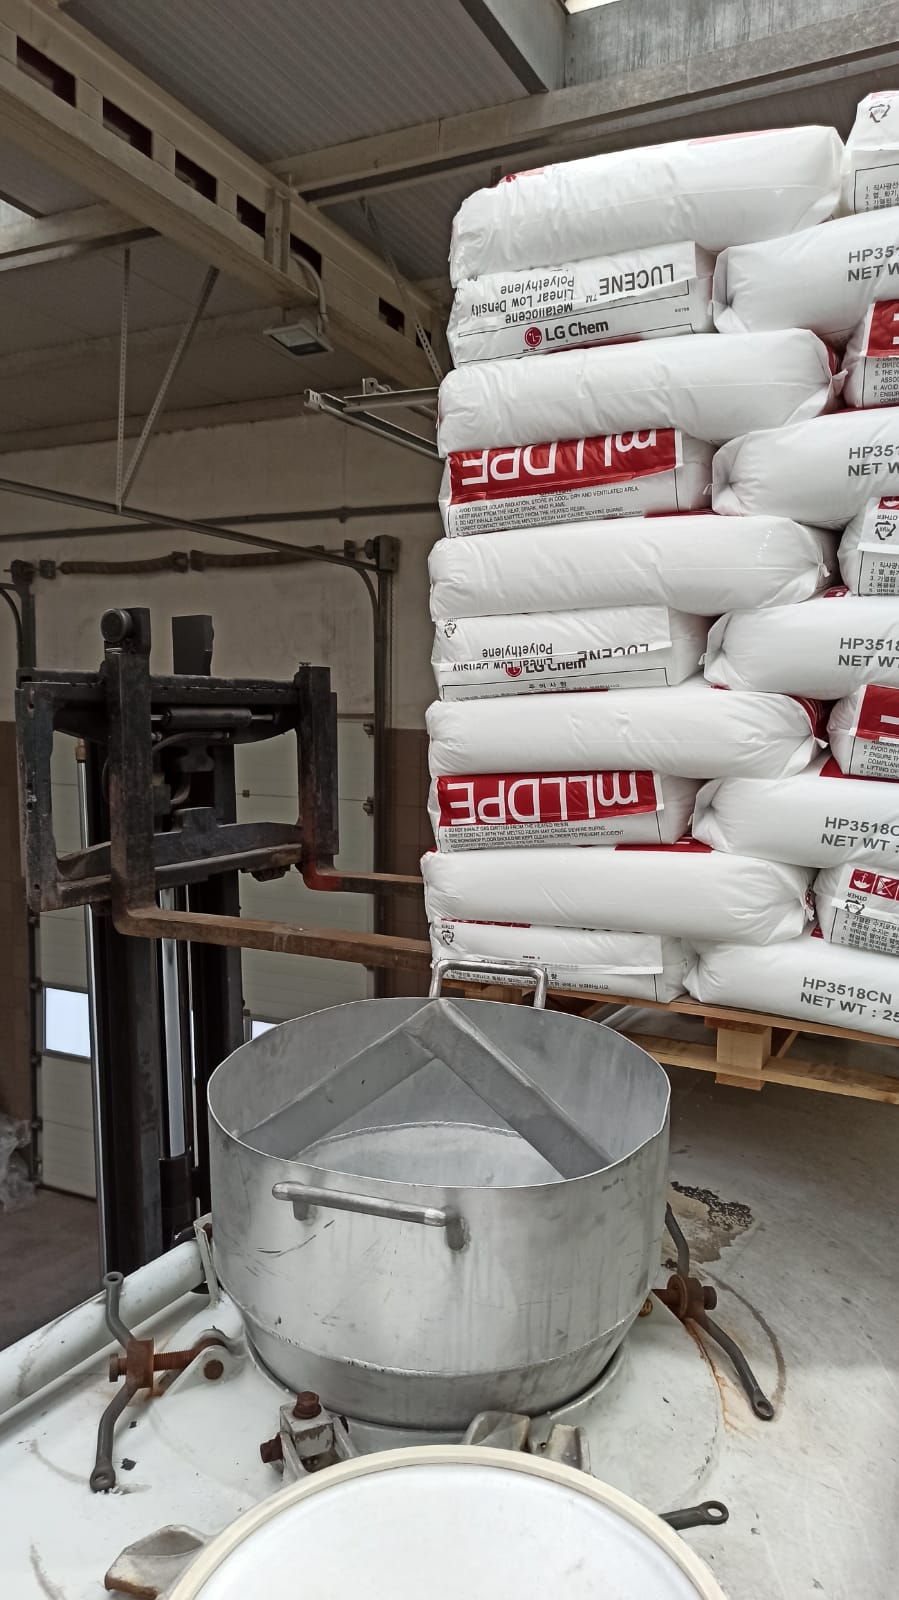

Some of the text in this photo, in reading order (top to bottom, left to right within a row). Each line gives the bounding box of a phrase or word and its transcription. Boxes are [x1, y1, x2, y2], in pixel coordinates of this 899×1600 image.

[848, 264, 883, 282] NET
[500, 275, 575, 295] Polyethylene
[470, 288, 575, 318] Linear Low Density
[544, 320, 609, 342] LG Chem
[848, 462, 882, 477] NET
[482, 643, 553, 658] Polyethylene
[838, 654, 874, 667] NET
[447, 771, 639, 825] mLLDPE
[820, 833, 890, 851] NET WT
[802, 977, 892, 1006] HP3518CN
[800, 991, 835, 1009] NET
[839, 1000, 867, 1016] WT
